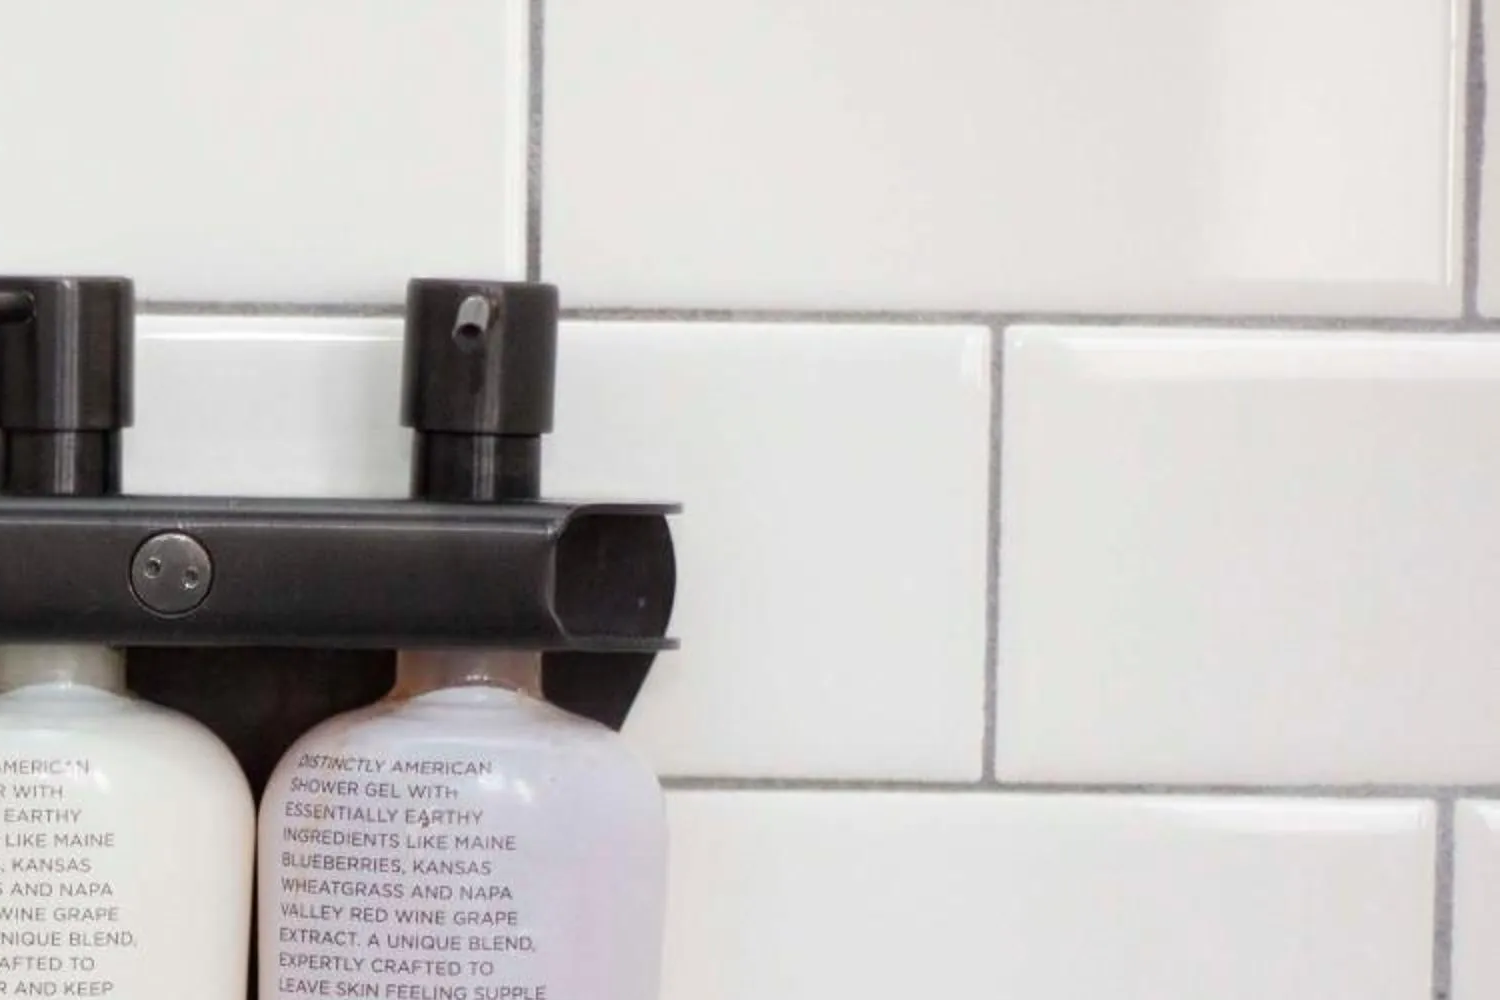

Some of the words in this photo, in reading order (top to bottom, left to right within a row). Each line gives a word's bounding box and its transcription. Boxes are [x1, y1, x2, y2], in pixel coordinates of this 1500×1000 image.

[298, 753, 385, 774] DISTINCTLY
[392, 759, 493, 776] AMERICAN
[13, 784, 64, 799] WITH
[290, 778, 359, 796] SHOWER
[365, 782, 401, 798] GEL
[3, 809, 82, 824] EARTHY
[285, 802, 397, 823] ESSENTIALLY
[405, 809, 483, 828] EARTHY
[5, 832, 47, 848] LIKE
[54, 832, 115, 848] MAINE
[283, 828, 400, 849] INGREDIENTS
[406, 835, 448, 850] LIKE
[455, 835, 516, 851] MAINE
[12, 857, 92, 873] KANSAS
[281, 852, 406, 875] BLUEBERRIES,
[413, 859, 492, 876] KANSAS
[10, 882, 53, 897] AND
[60, 882, 113, 897] NAPA
[281, 877, 404, 898] WHEATGRASS
[410, 884, 452, 899] AND
[460, 885, 512, 900] NAPA
[53, 906, 119, 922] GRAPE
[280, 903, 343, 921] VALLEY
[350, 907, 387, 923] RED
[395, 910, 446, 925] WINE
[453, 910, 518, 927] GRAPE
[367, 933, 381, 948] A
[387, 934, 461, 951] UNIQUE
[70, 956, 95, 973] TO
[279, 953, 365, 973] EXPERTLY
[371, 958, 461, 976] CRAFTED
[468, 960, 494, 977] TO
[14, 980, 57, 996] AND
[64, 980, 114, 996] KEEP
[279, 978, 329, 995] LEAVE
[336, 981, 379, 999] SKIN
[385, 984, 468, 1000] FEELING
[474, 986, 547, 1000] SUPPLE
